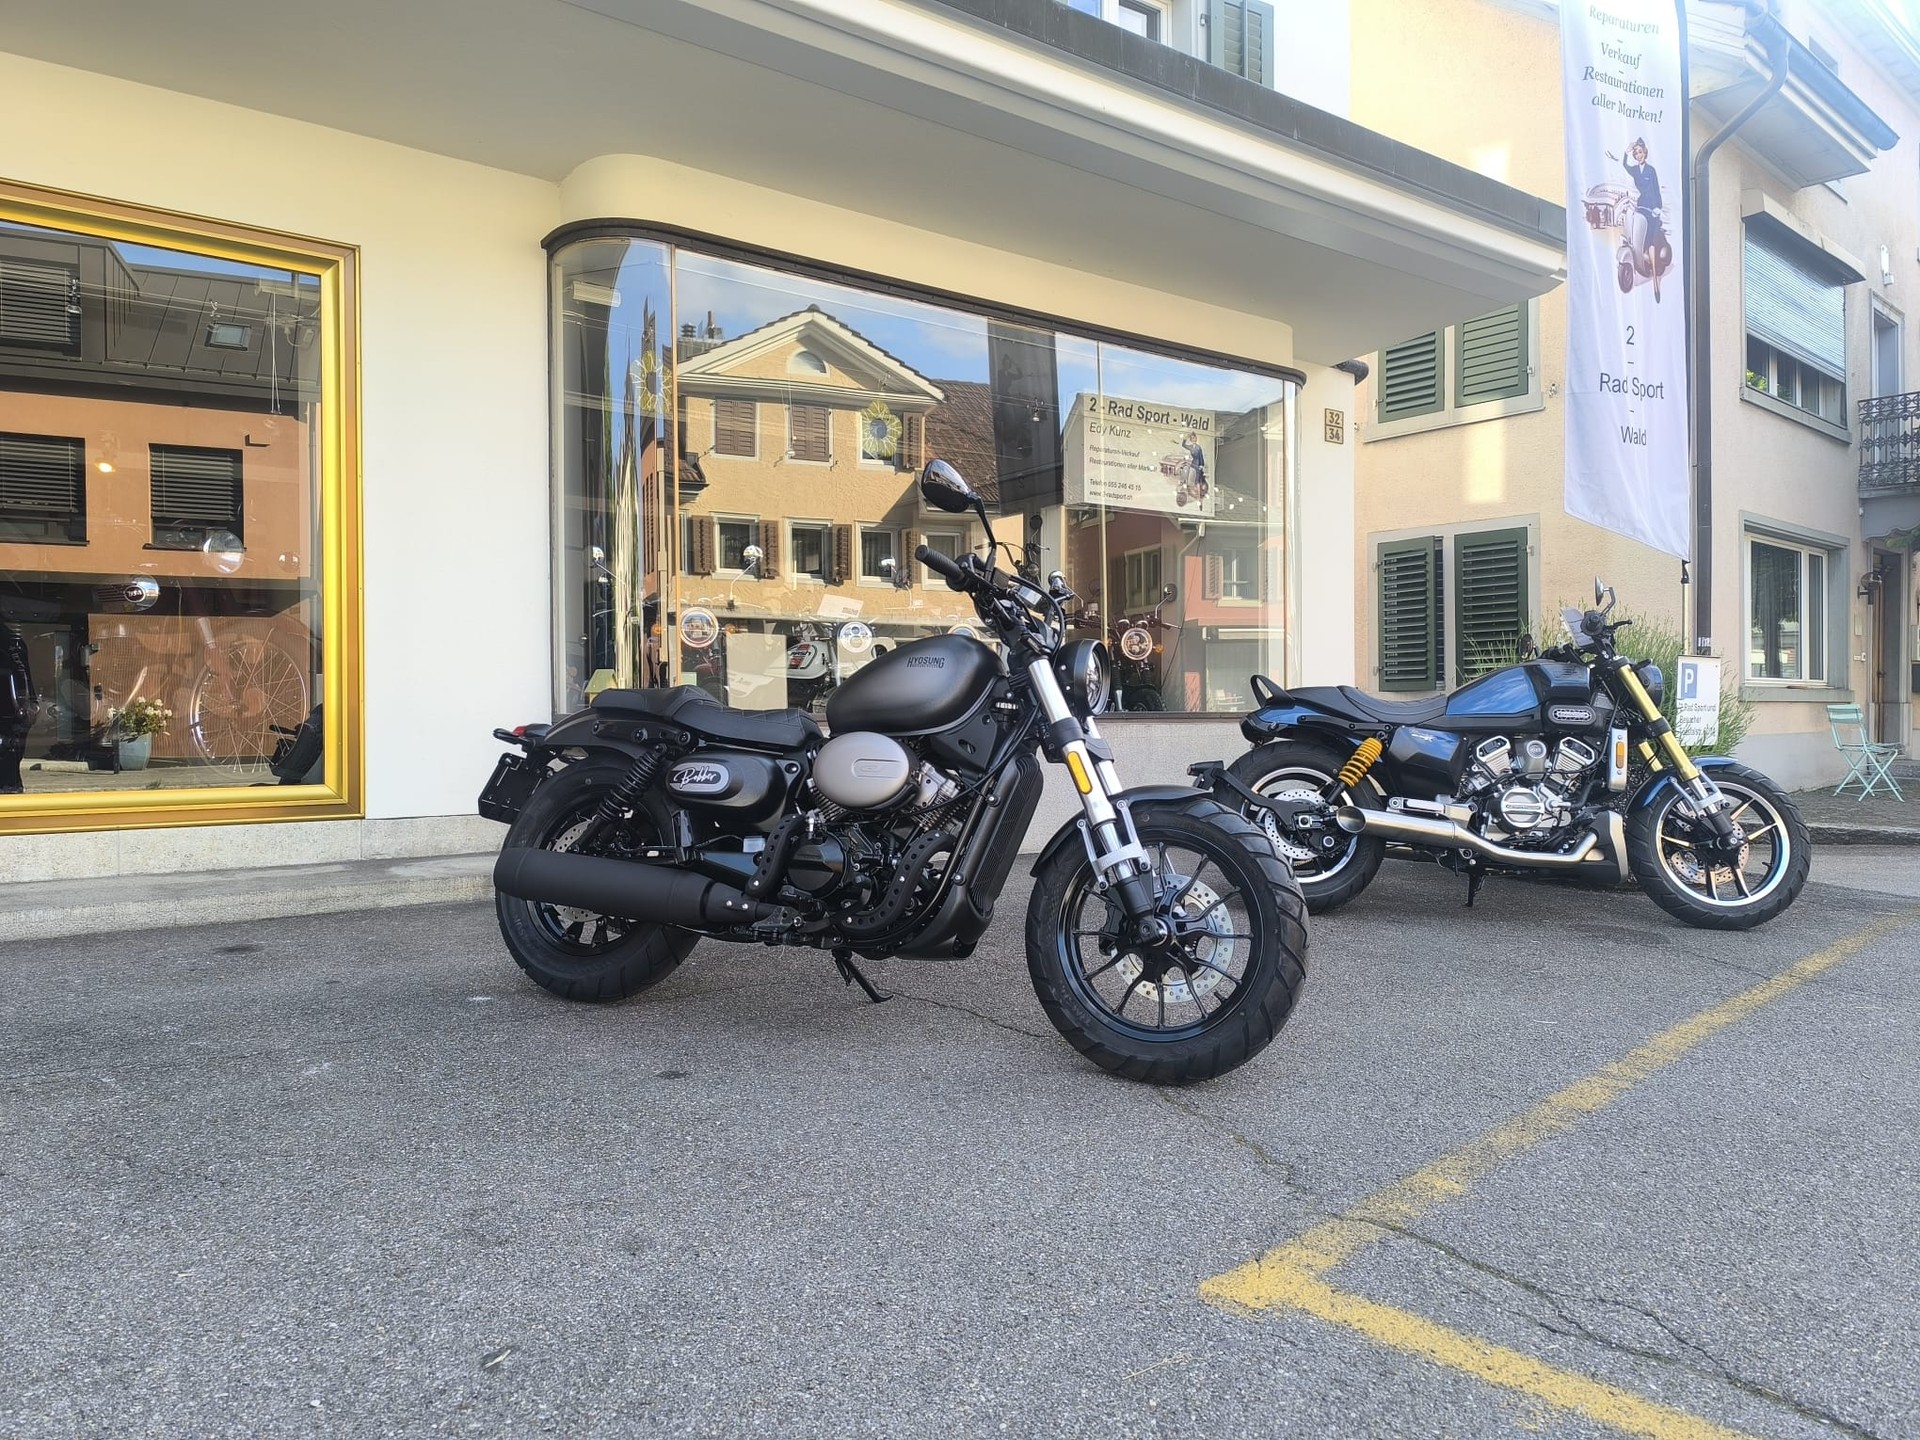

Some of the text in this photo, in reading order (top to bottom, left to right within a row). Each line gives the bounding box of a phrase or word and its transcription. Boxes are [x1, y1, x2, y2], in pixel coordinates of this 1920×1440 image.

[1589, 4, 1660, 35] Reparaturen
[1600, 41, 1642, 70] Verkauf
[1582, 65, 1665, 99] Restaurationen
[1591, 92, 1663, 124] aller Marken!
[1625, 325, 1635, 346] 2
[1599, 373, 1665, 401] Rad Sport
[1089, 397, 1097, 412] 2
[1108, 400, 1134, 418] Rad
[1136, 405, 1171, 424] Sport
[1181, 413, 1210, 431] Wald
[1329, 411, 1340, 425] 32
[1109, 424, 1132, 438] Kunz
[1329, 428, 1340, 441] 34
[1620, 425, 1647, 446] Wald
[907, 656, 945, 668] HYOSUNG
[1684, 668, 1694, 693] P
[673, 765, 717, 789] Bobber
